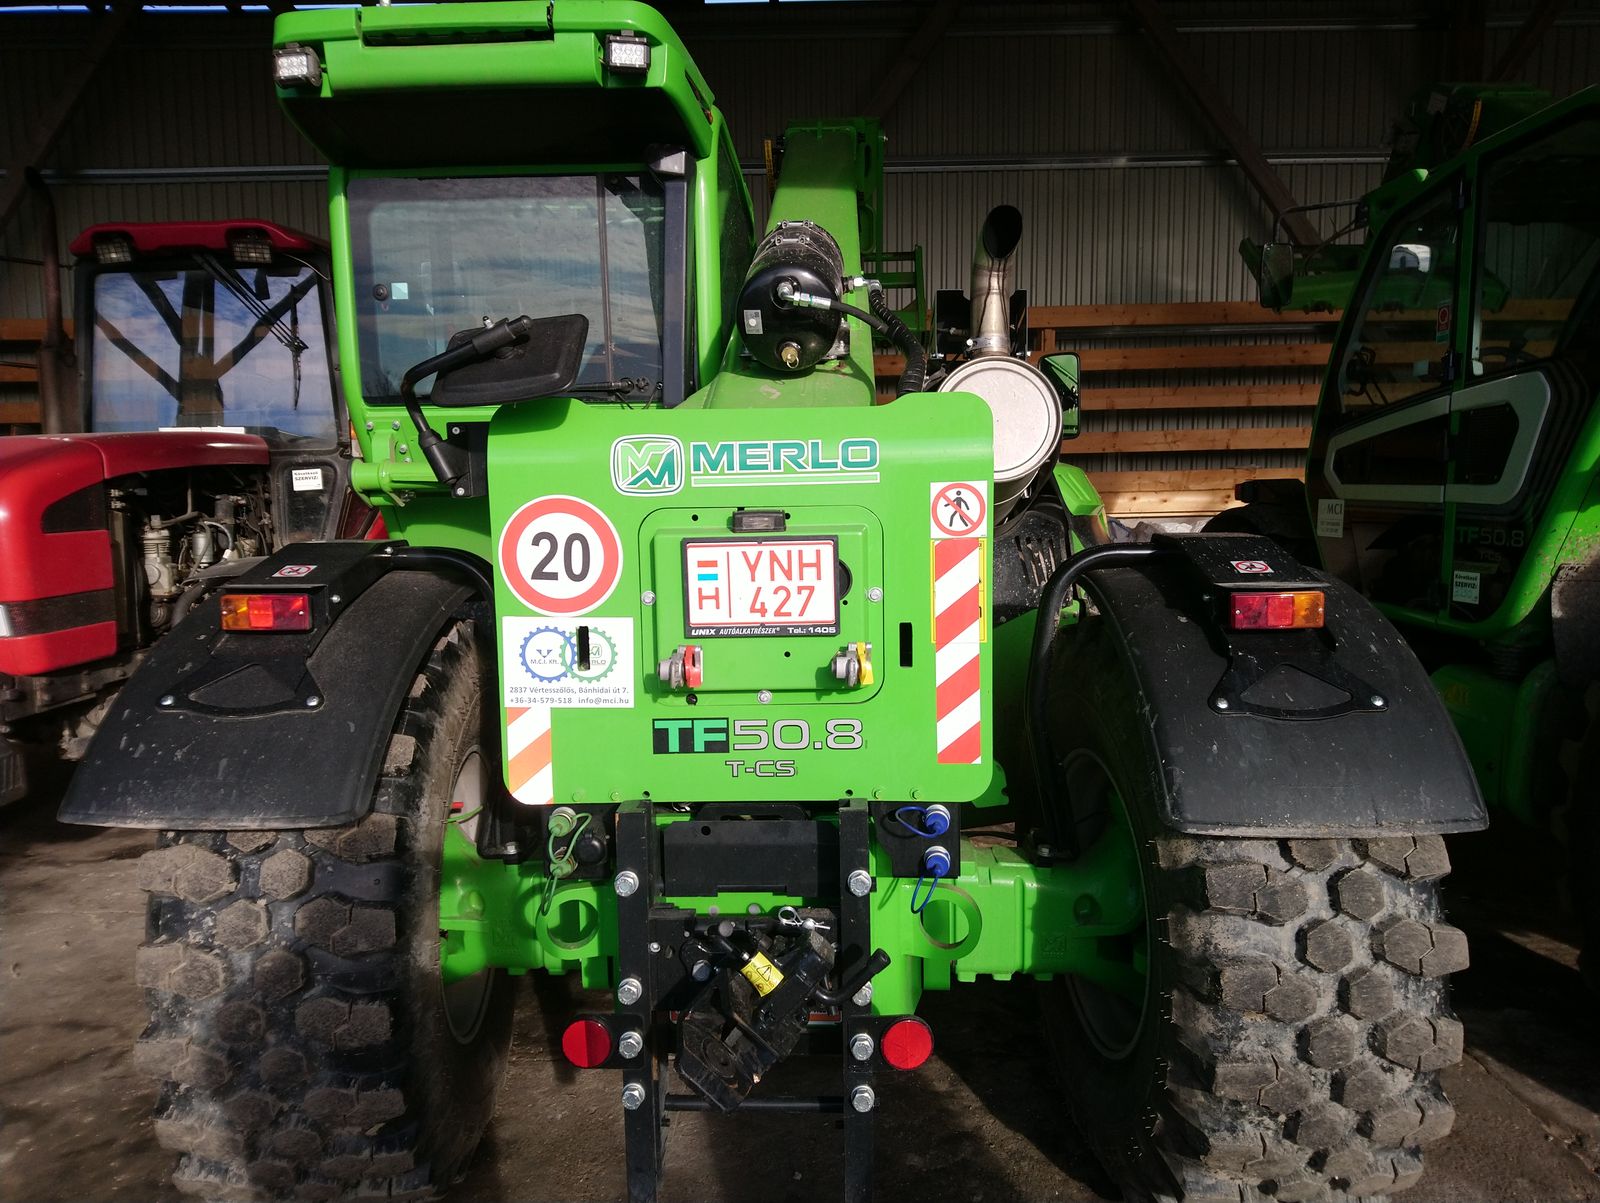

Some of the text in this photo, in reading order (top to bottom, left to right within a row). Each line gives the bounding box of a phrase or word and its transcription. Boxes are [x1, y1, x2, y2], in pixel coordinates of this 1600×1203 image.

[690, 438, 880, 474] MERLO
[1456, 526, 1525, 548] TF50.8
[530, 531, 591, 583] 20
[741, 549, 822, 582] YNH
[698, 587, 720, 610] H
[749, 585, 816, 617] 427
[691, 628, 716, 636] UNIX
[510, 686, 527, 694] 2837
[578, 686, 611, 694] Bánhidai
[578, 697, 629, 705] info@mci.hu
[652, 717, 863, 755] TF50.8
[725, 760, 797, 778] T-CS
